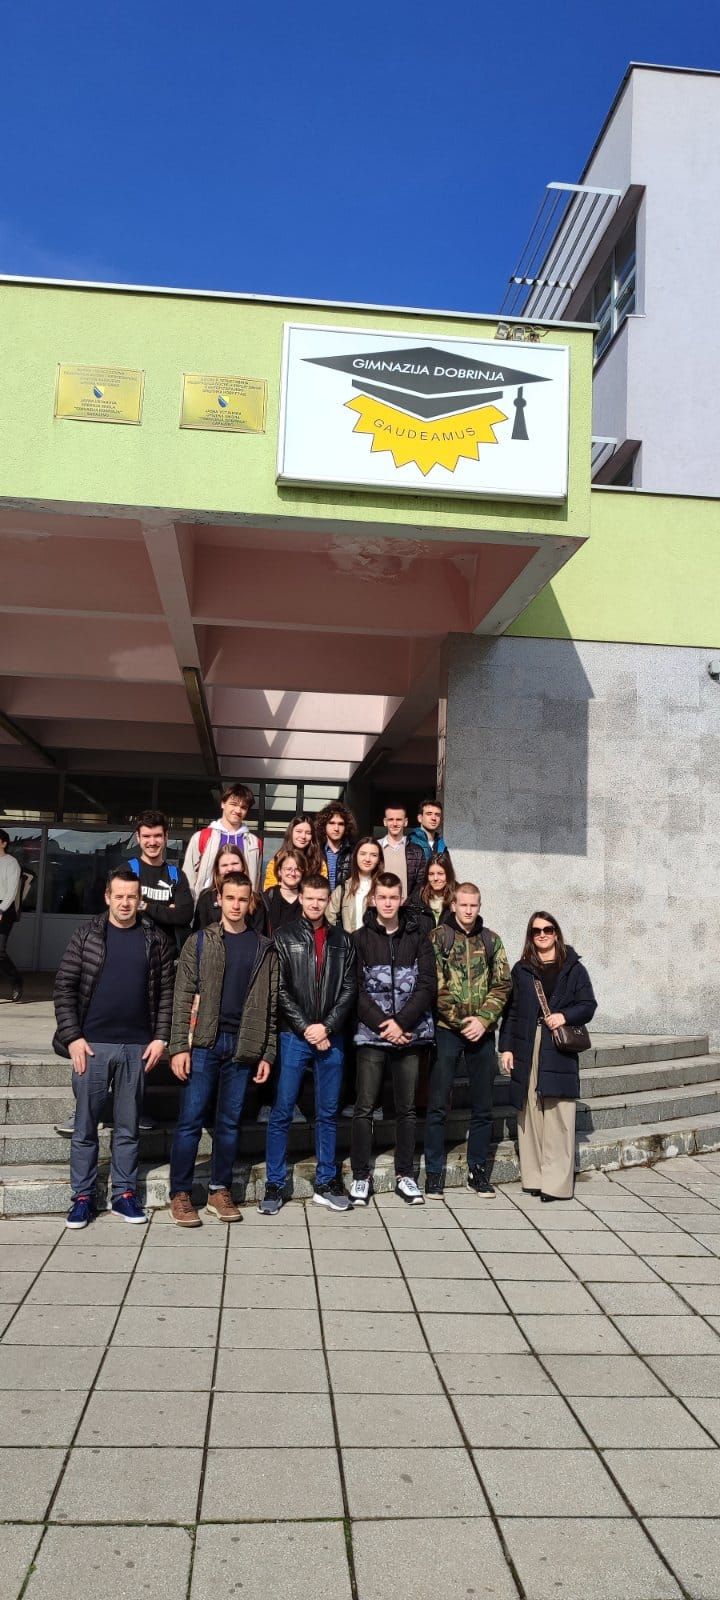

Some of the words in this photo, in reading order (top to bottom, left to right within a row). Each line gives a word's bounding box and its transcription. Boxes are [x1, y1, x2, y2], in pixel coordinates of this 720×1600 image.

[352, 358, 430, 375] GIMNAZIJA
[434, 366, 505, 382] DOBRINJA
[373, 418, 477, 441] GAUDEAMUS
[141, 886, 170, 901] PUMA
